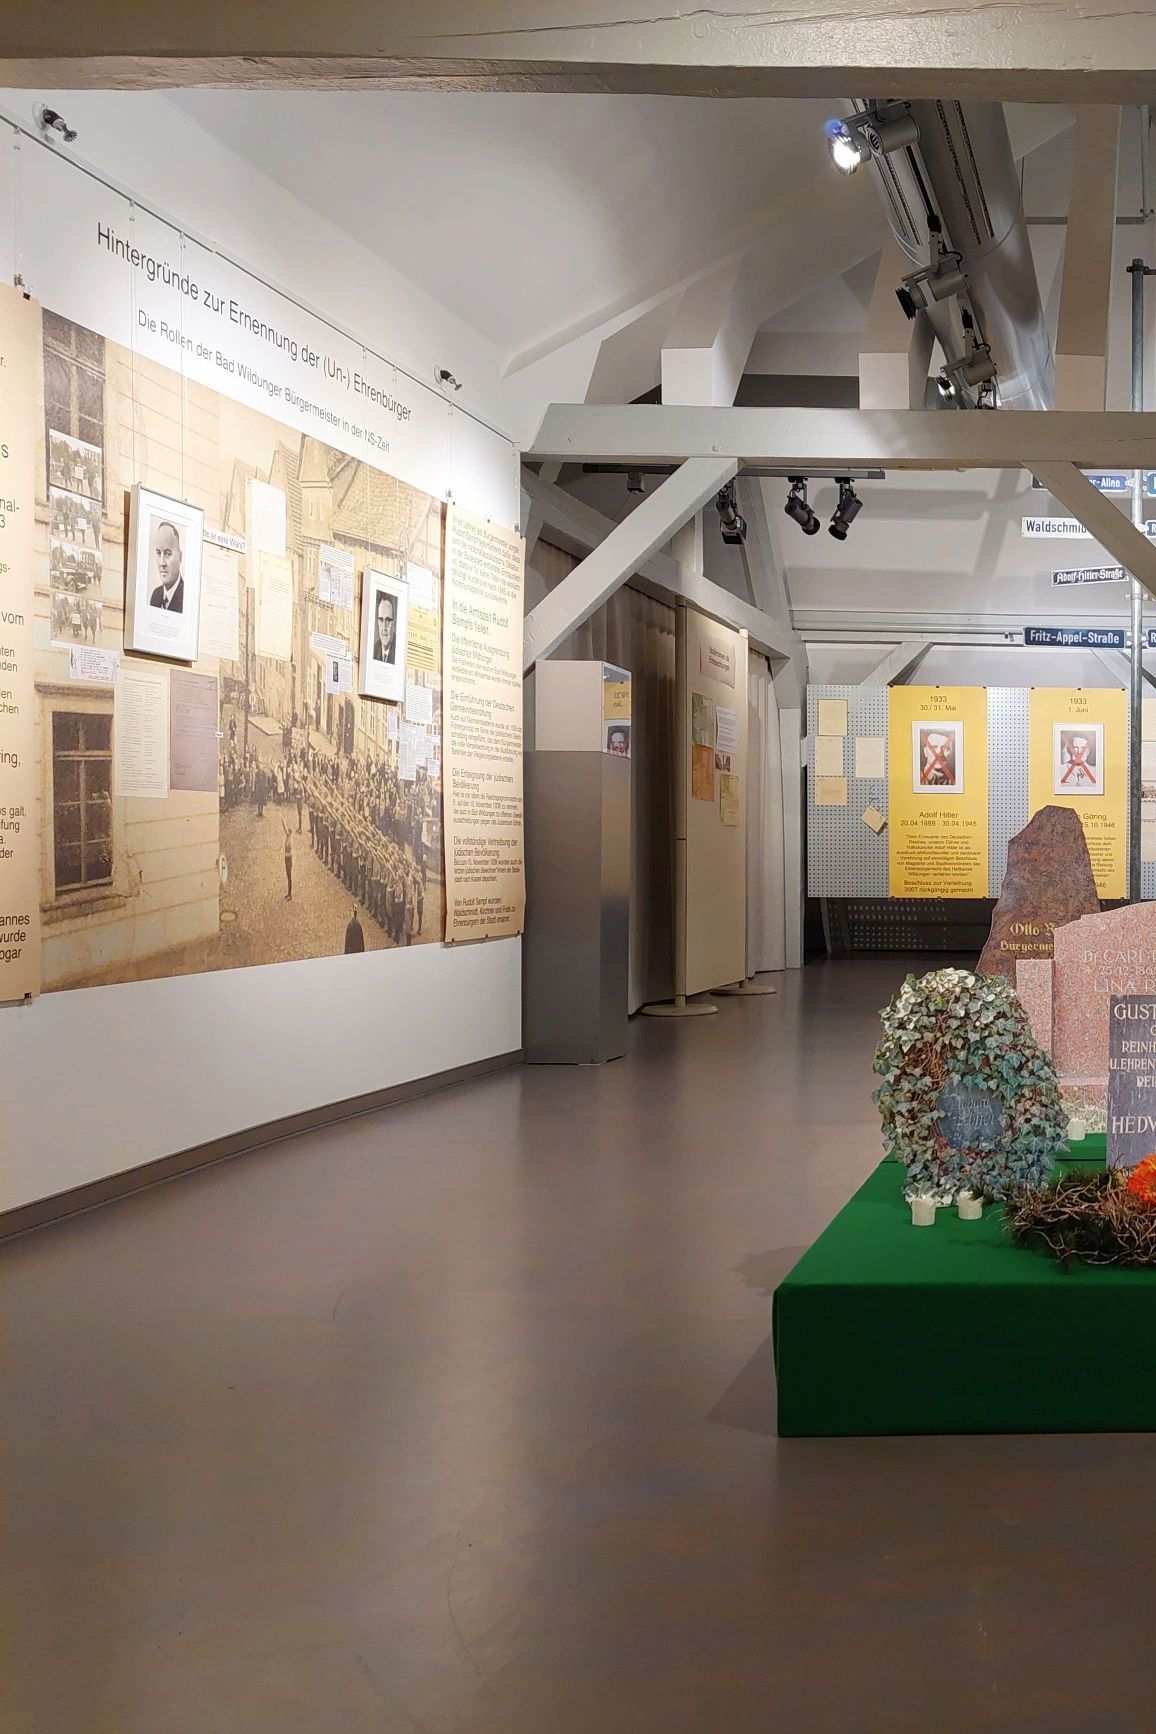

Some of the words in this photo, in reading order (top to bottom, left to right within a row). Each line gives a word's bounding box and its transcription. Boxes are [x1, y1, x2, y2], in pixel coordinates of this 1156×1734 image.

[97, 222, 199, 300] Hintergründe
[203, 290, 225, 315] zur
[229, 299, 298, 362] Ernennung
[301, 344, 320, 369] der
[323, 355, 351, 391] (Un-)
[353, 372, 412, 421] Ehrenbürger
[138, 309, 157, 333] Die
[160, 320, 193, 352] Rollen
[196, 342, 213, 361] der
[215, 350, 235, 374] Bad
[237, 361, 282, 397] Wildunger
[284, 387, 341, 427] Bürgermeister
[342, 417, 350, 433] in
[350, 422, 363, 438] der
[1, 611, 25, 626] vom
[1029, 630, 1120, 645] Fritz-Appel-Straße
[930, 695, 948, 703] 1933
[945, 704, 957, 712] Mai
[919, 811, 938, 819] Adolf
[939, 811, 959, 819] Hitler
[1083, 812, 1108, 822] Göring
